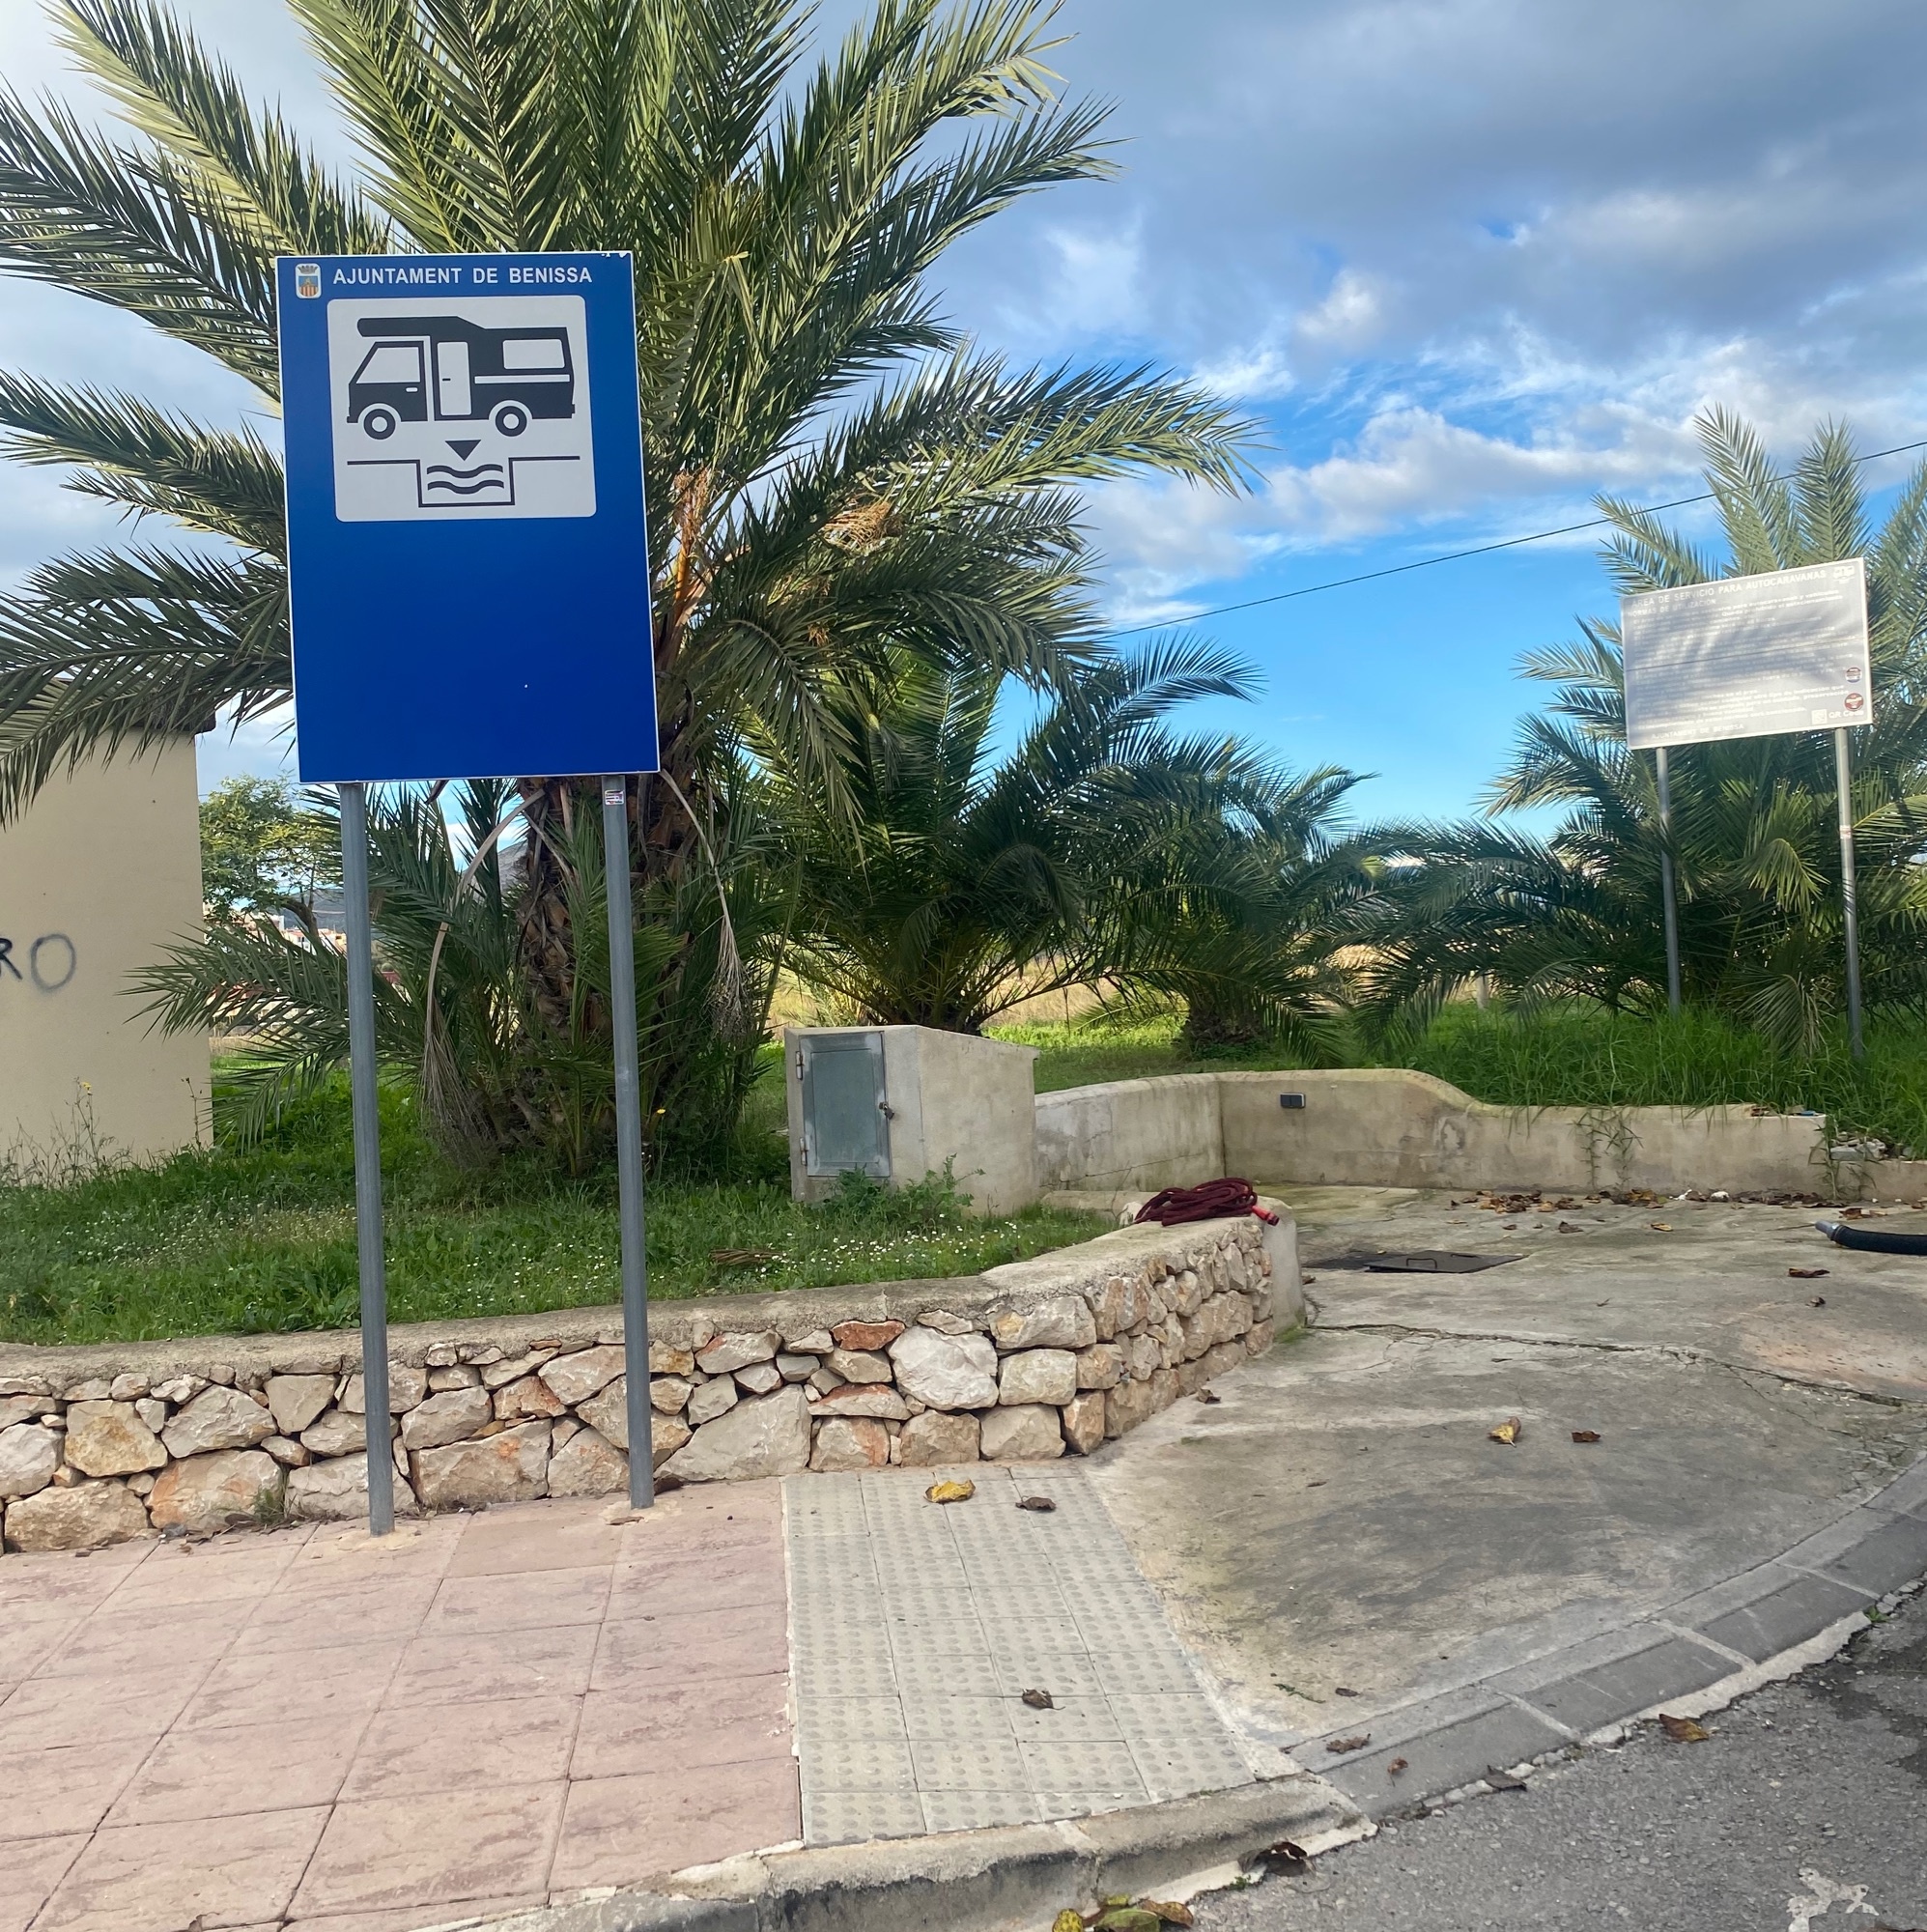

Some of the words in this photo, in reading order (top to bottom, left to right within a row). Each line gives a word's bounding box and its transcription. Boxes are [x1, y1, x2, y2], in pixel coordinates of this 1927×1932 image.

[333, 268, 463, 285] AJUNTAMENT
[473, 268, 498, 284] DE
[509, 267, 593, 283] BENISSA
[1658, 595, 1670, 604] DE
[1674, 588, 1714, 601] SERVICIO
[1718, 583, 1742, 594] PARA
[1745, 570, 1827, 590] AUTOCARAVANAS
[1651, 728, 1696, 739] AJUNTAMENT
[1713, 724, 1744, 732] BENISSA
